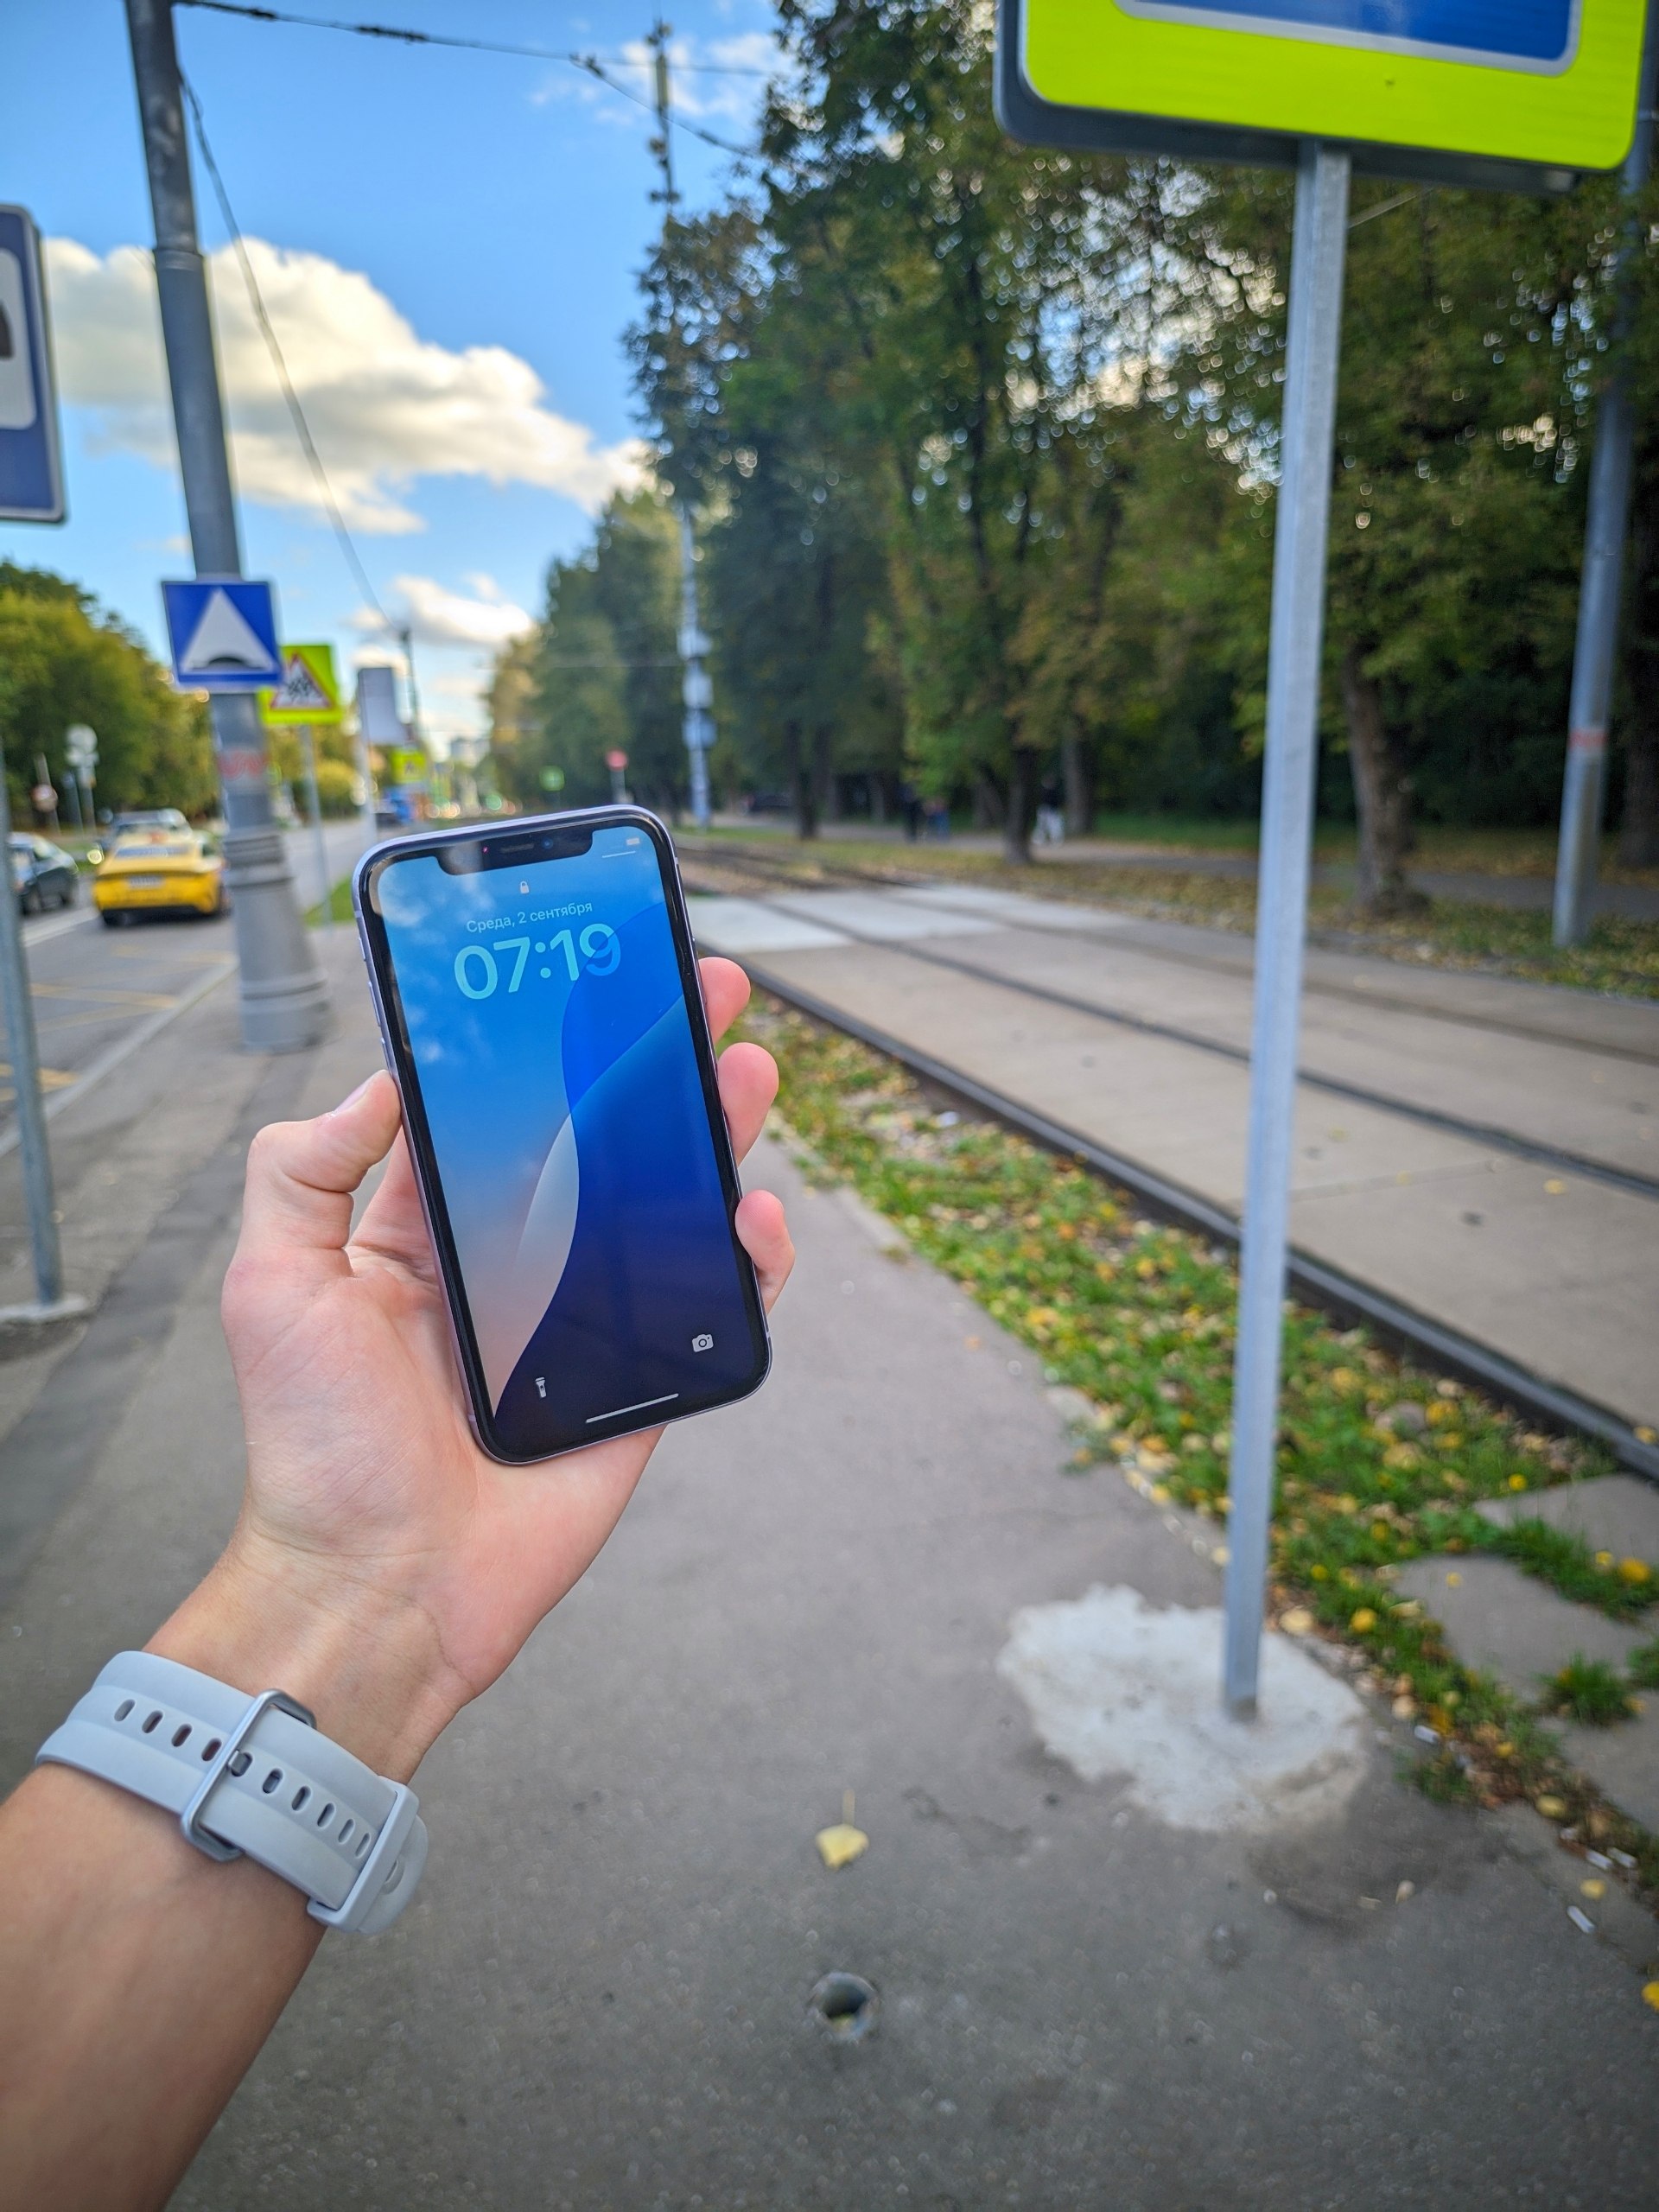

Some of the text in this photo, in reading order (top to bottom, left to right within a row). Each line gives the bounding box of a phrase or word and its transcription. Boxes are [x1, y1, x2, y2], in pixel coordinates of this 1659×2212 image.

[467, 902, 593, 933] Среда, 2 сентября
[454, 923, 621, 1000] 07:19
